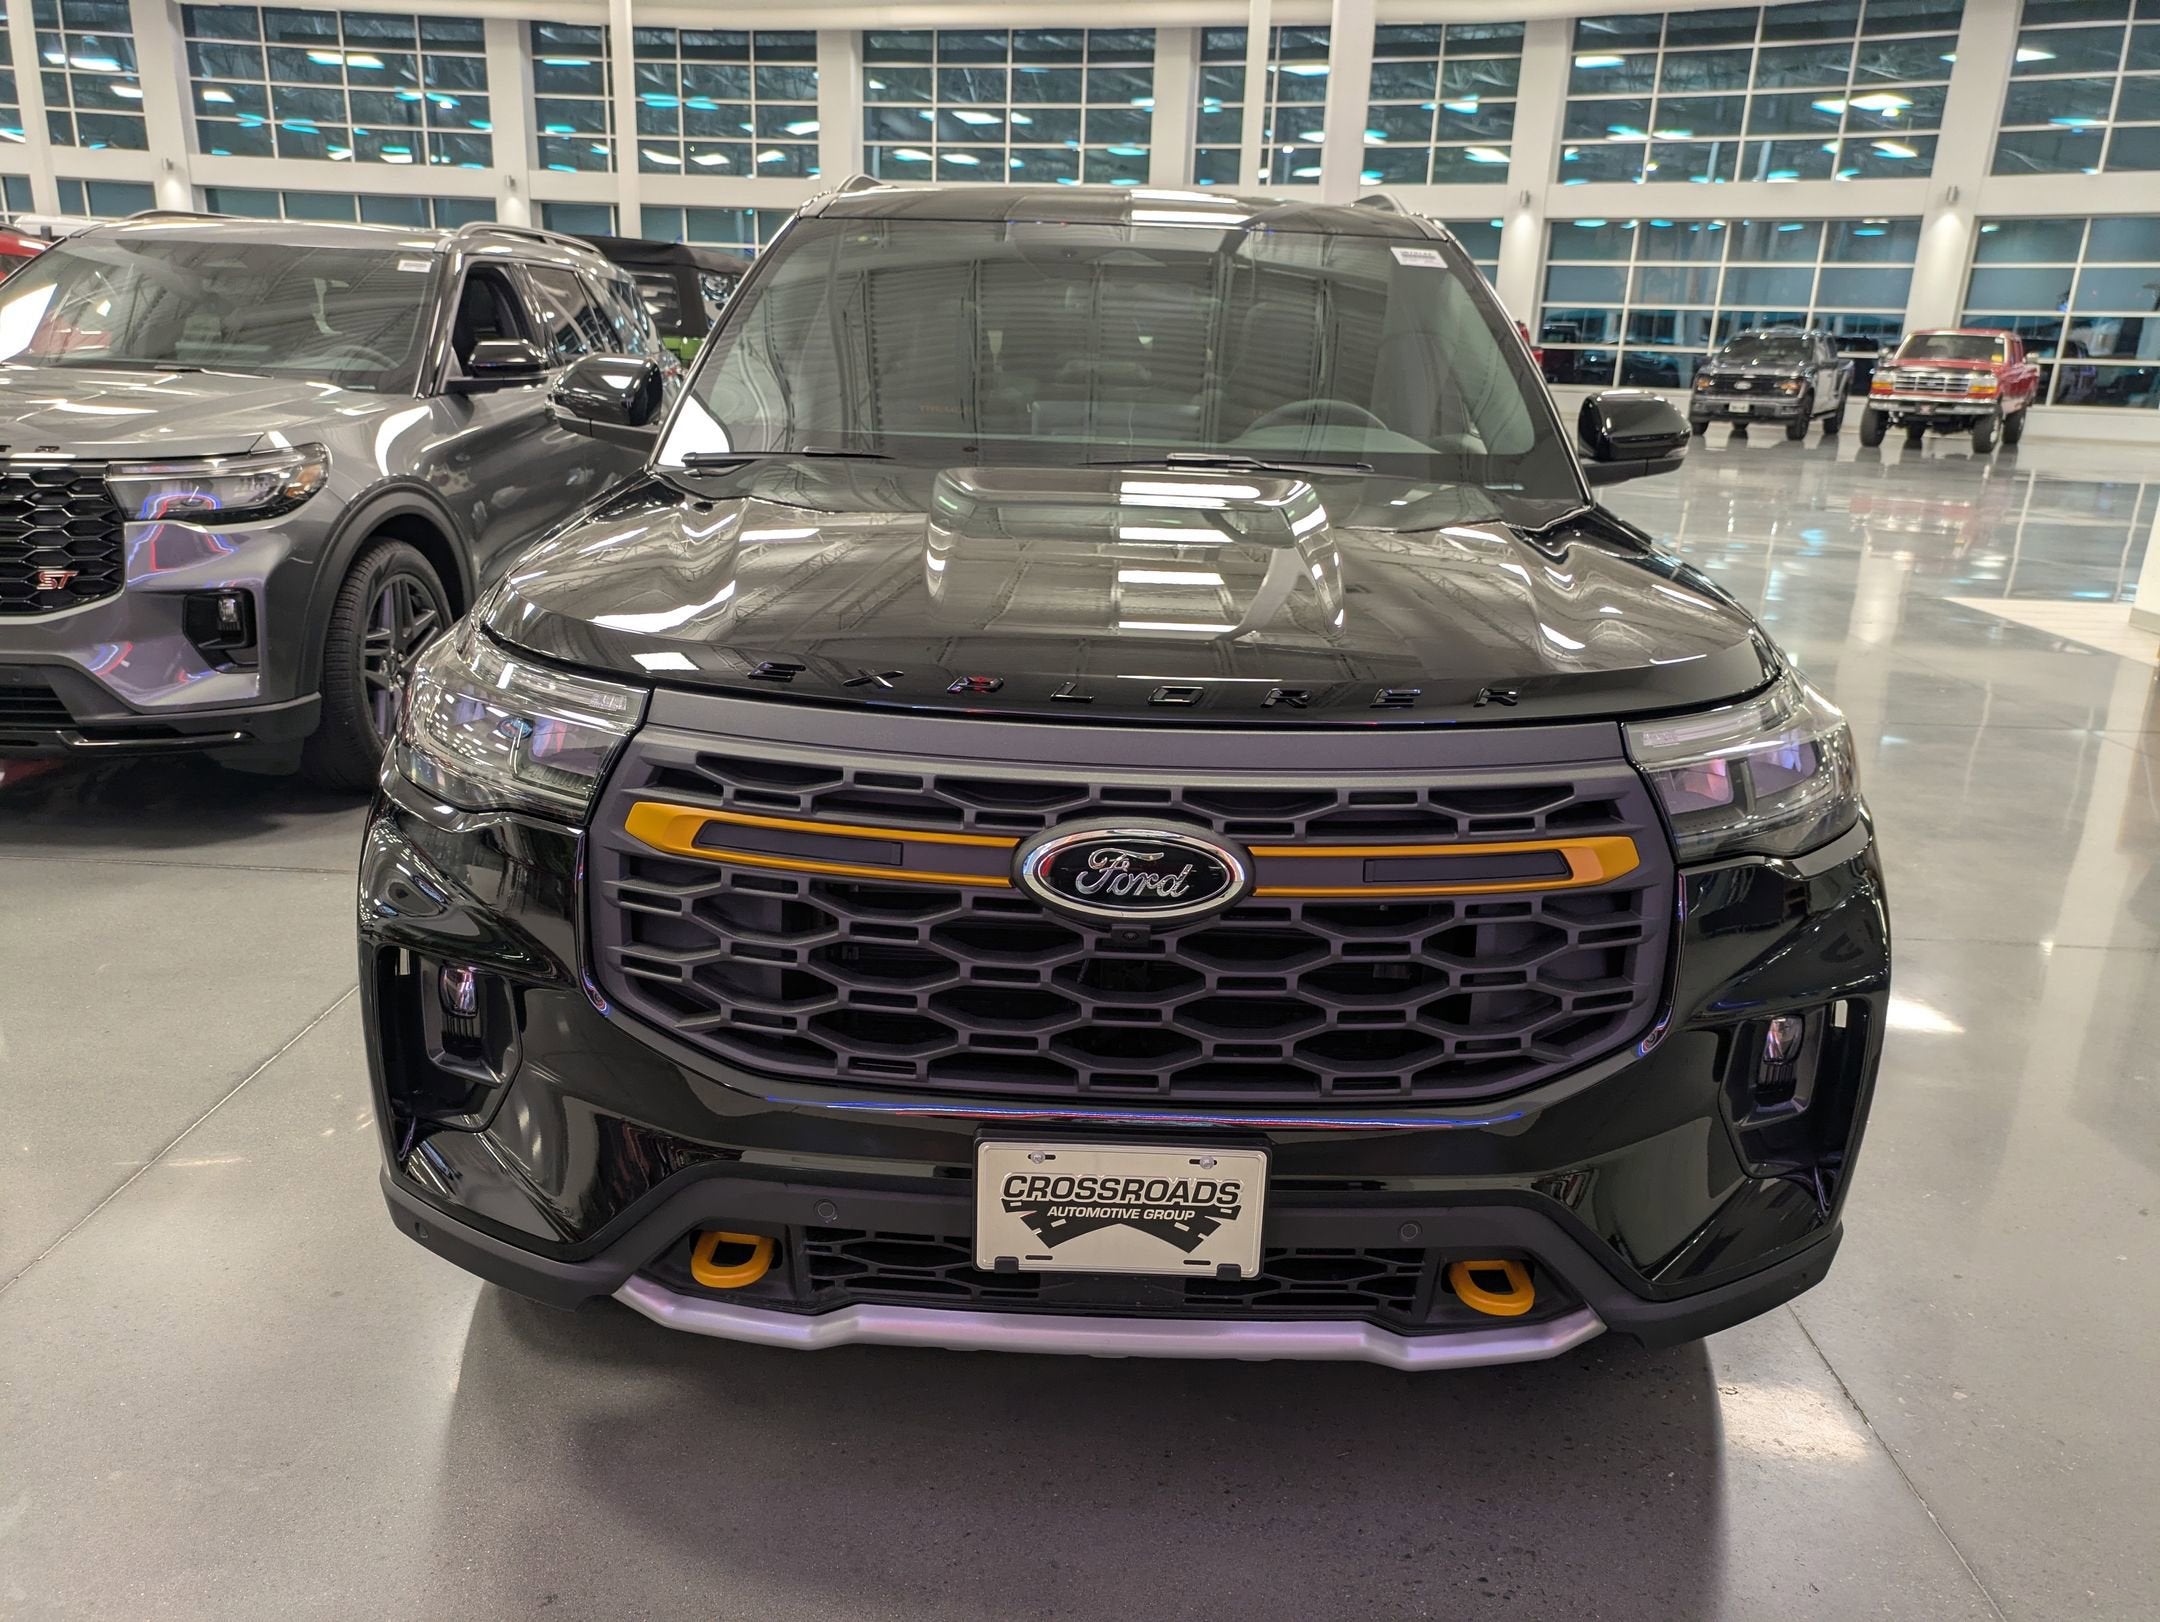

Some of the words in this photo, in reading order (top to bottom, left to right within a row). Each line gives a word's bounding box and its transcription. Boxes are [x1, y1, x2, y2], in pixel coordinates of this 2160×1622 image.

[36, 570, 79, 589] ST
[747, 661, 1520, 708] EXPLORER
[1075, 847, 1194, 897] Ford
[1002, 1174, 1241, 1205] CROSSROADS
[1046, 1205, 1139, 1219] AUTOMOTIVE
[1143, 1207, 1196, 1221] GROUP
